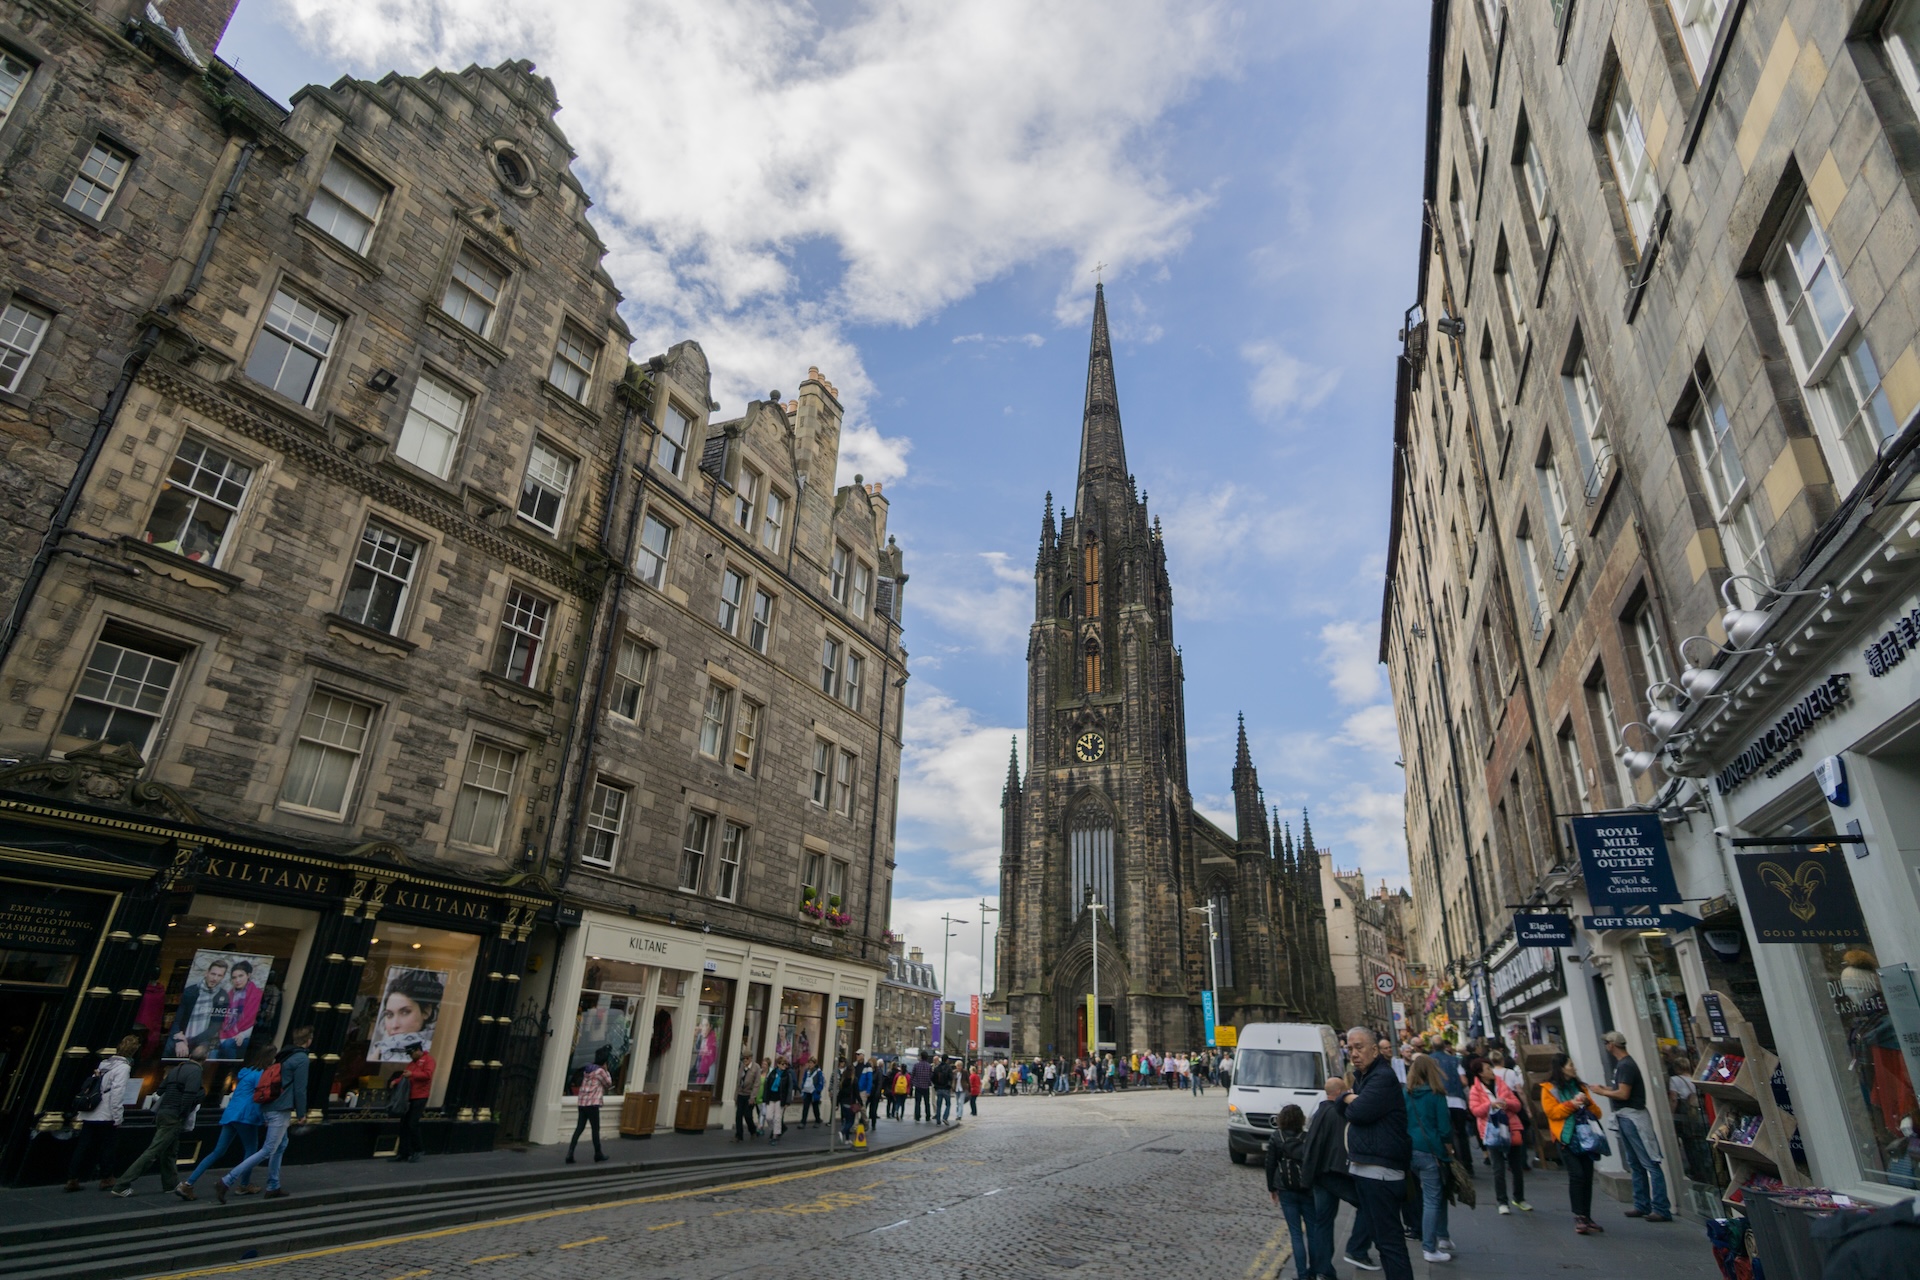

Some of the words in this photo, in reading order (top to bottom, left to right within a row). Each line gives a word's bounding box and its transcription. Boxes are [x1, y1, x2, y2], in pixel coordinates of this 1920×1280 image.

[1715, 738, 1767, 795] DUNEDIN
[1764, 674, 1848, 754] CASHMERE
[1596, 827, 1642, 837] ROYAL
[1603, 837, 1639, 847] MILE
[1592, 847, 1655, 858] FACTORY
[1597, 857, 1654, 868] OUTLET
[205, 857, 329, 893] KILTANE
[1610, 876, 1638, 885] Wool
[1640, 876, 1651, 885] &
[1607, 885, 1658, 894] Cashmere
[9, 904, 55, 916] EXPERTS
[58, 910, 72, 918] IN
[394, 890, 489, 921] KILTANE
[562, 908, 576, 916] 332
[35, 917, 94, 931] CLOTHING,
[1528, 922, 1554, 932] Elgin
[1593, 918, 1623, 927] GIFT
[1626, 917, 1661, 927] SHOP
[0, 922, 57, 936] CASHMERE
[60, 928, 68, 936] &
[1521, 931, 1566, 939] Cashmere
[1802, 929, 1860, 937] REWARDS
[18, 934, 77, 947] WOOLLENS
[629, 936, 668, 955] KILTANE
[1378, 978, 1394, 988] 20
[1826, 973, 1878, 998] DUDIN
[1203, 992, 1213, 1021] TICKETS
[1833, 997, 1884, 1015] CASHMERE
[933, 1000, 941, 1025] EVENTS
